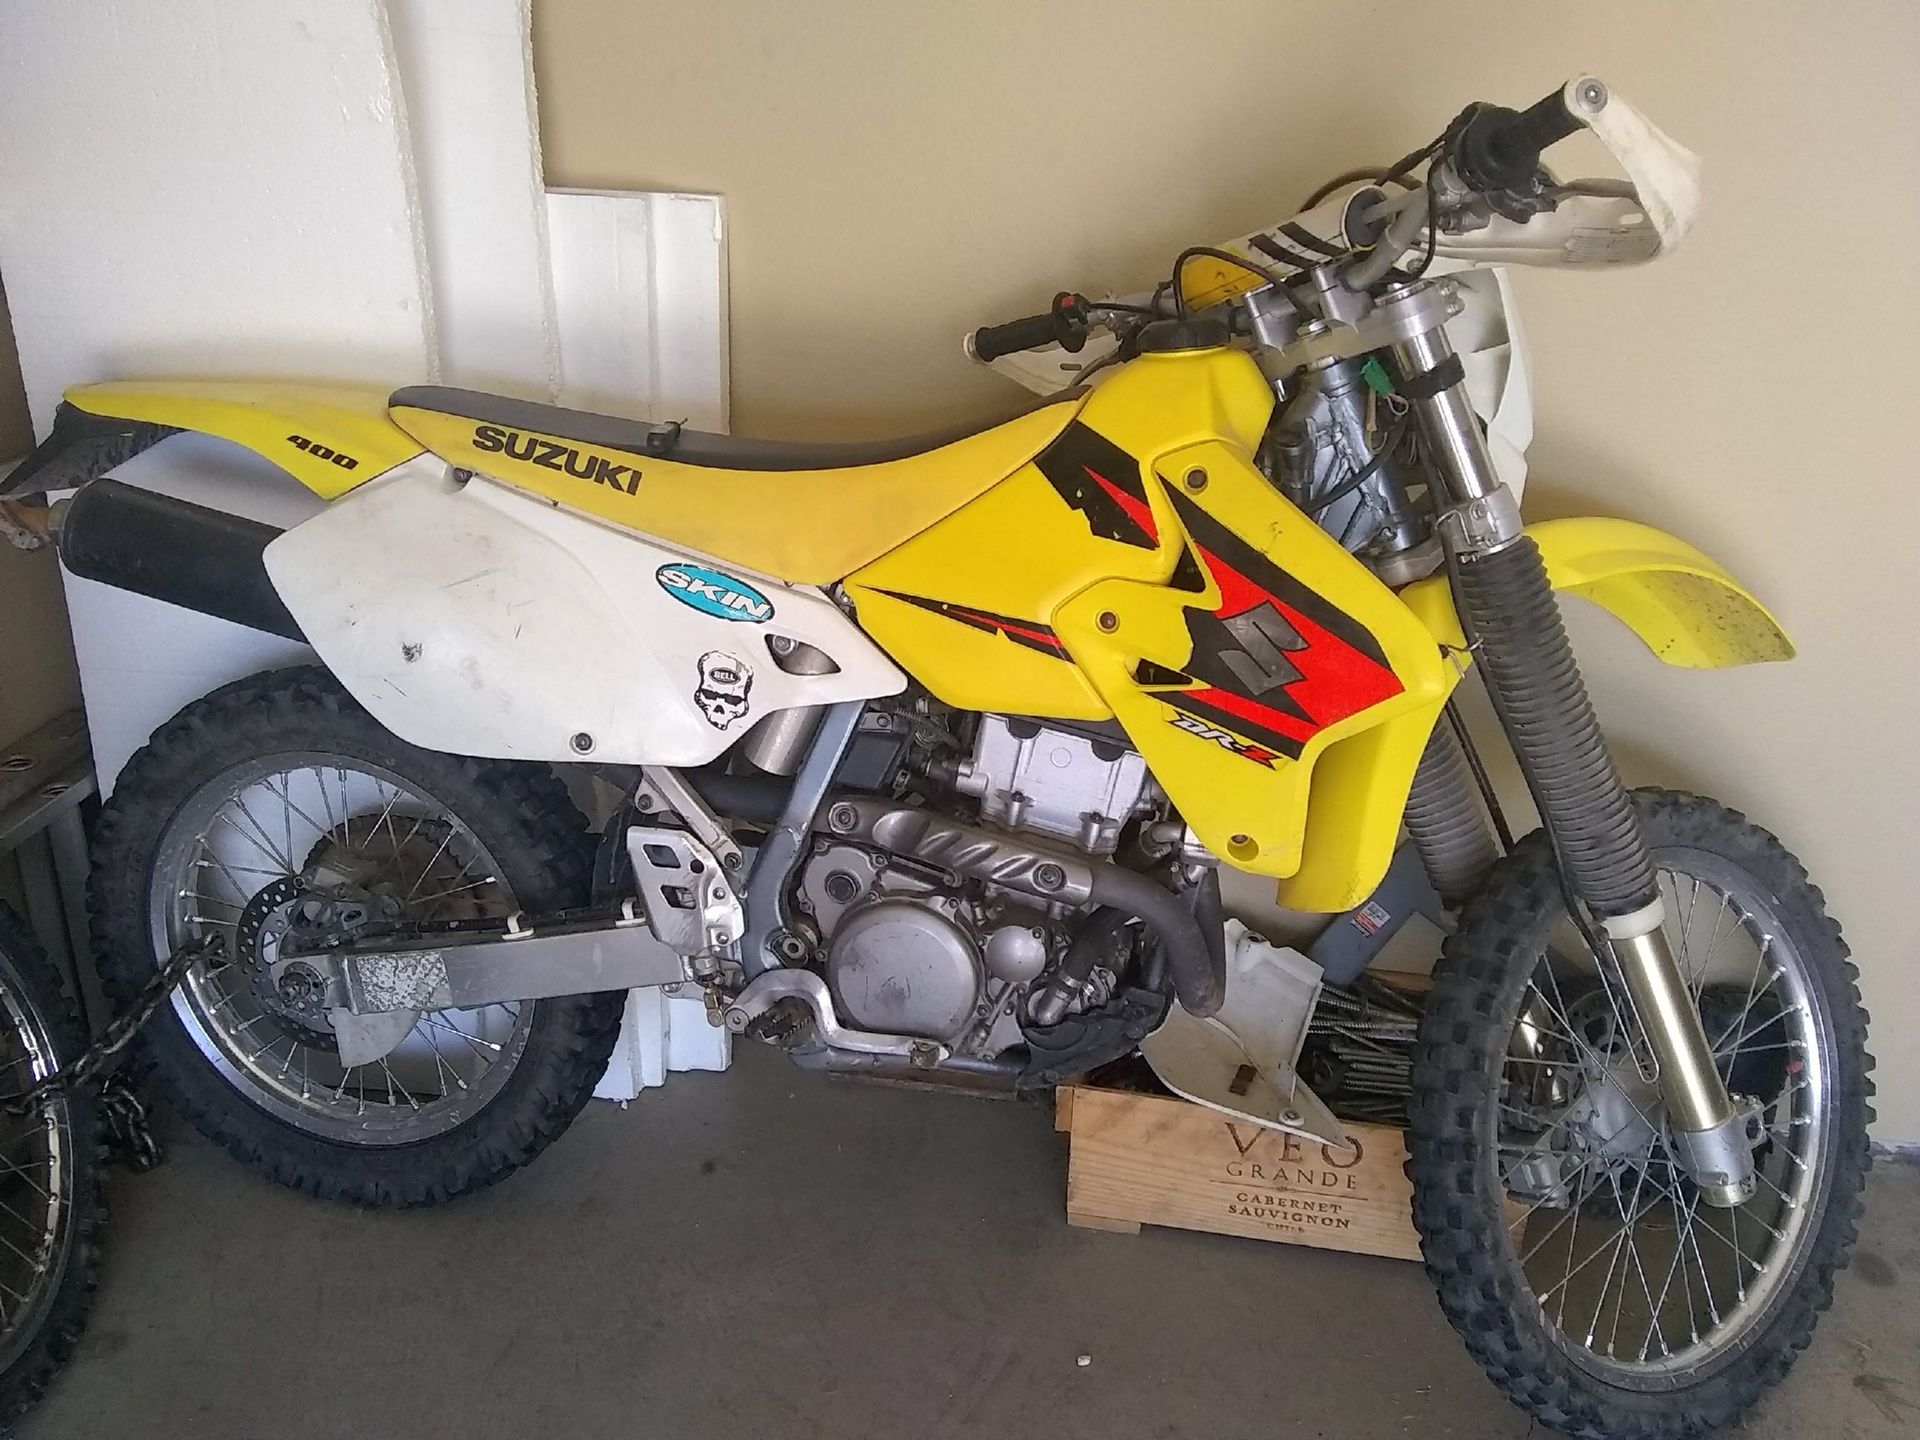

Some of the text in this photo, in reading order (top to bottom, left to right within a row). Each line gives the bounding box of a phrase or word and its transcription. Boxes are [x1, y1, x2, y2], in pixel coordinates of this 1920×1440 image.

[286, 435, 359, 470] 400
[472, 425, 643, 496] SUZUKI
[658, 569, 771, 618] SKIN
[713, 670, 736, 682] BELL
[1226, 1161, 1357, 1190] GRANDE
[1228, 1204, 1351, 1229] SAUVIGNON
[1236, 1192, 1343, 1215] CABERNET
